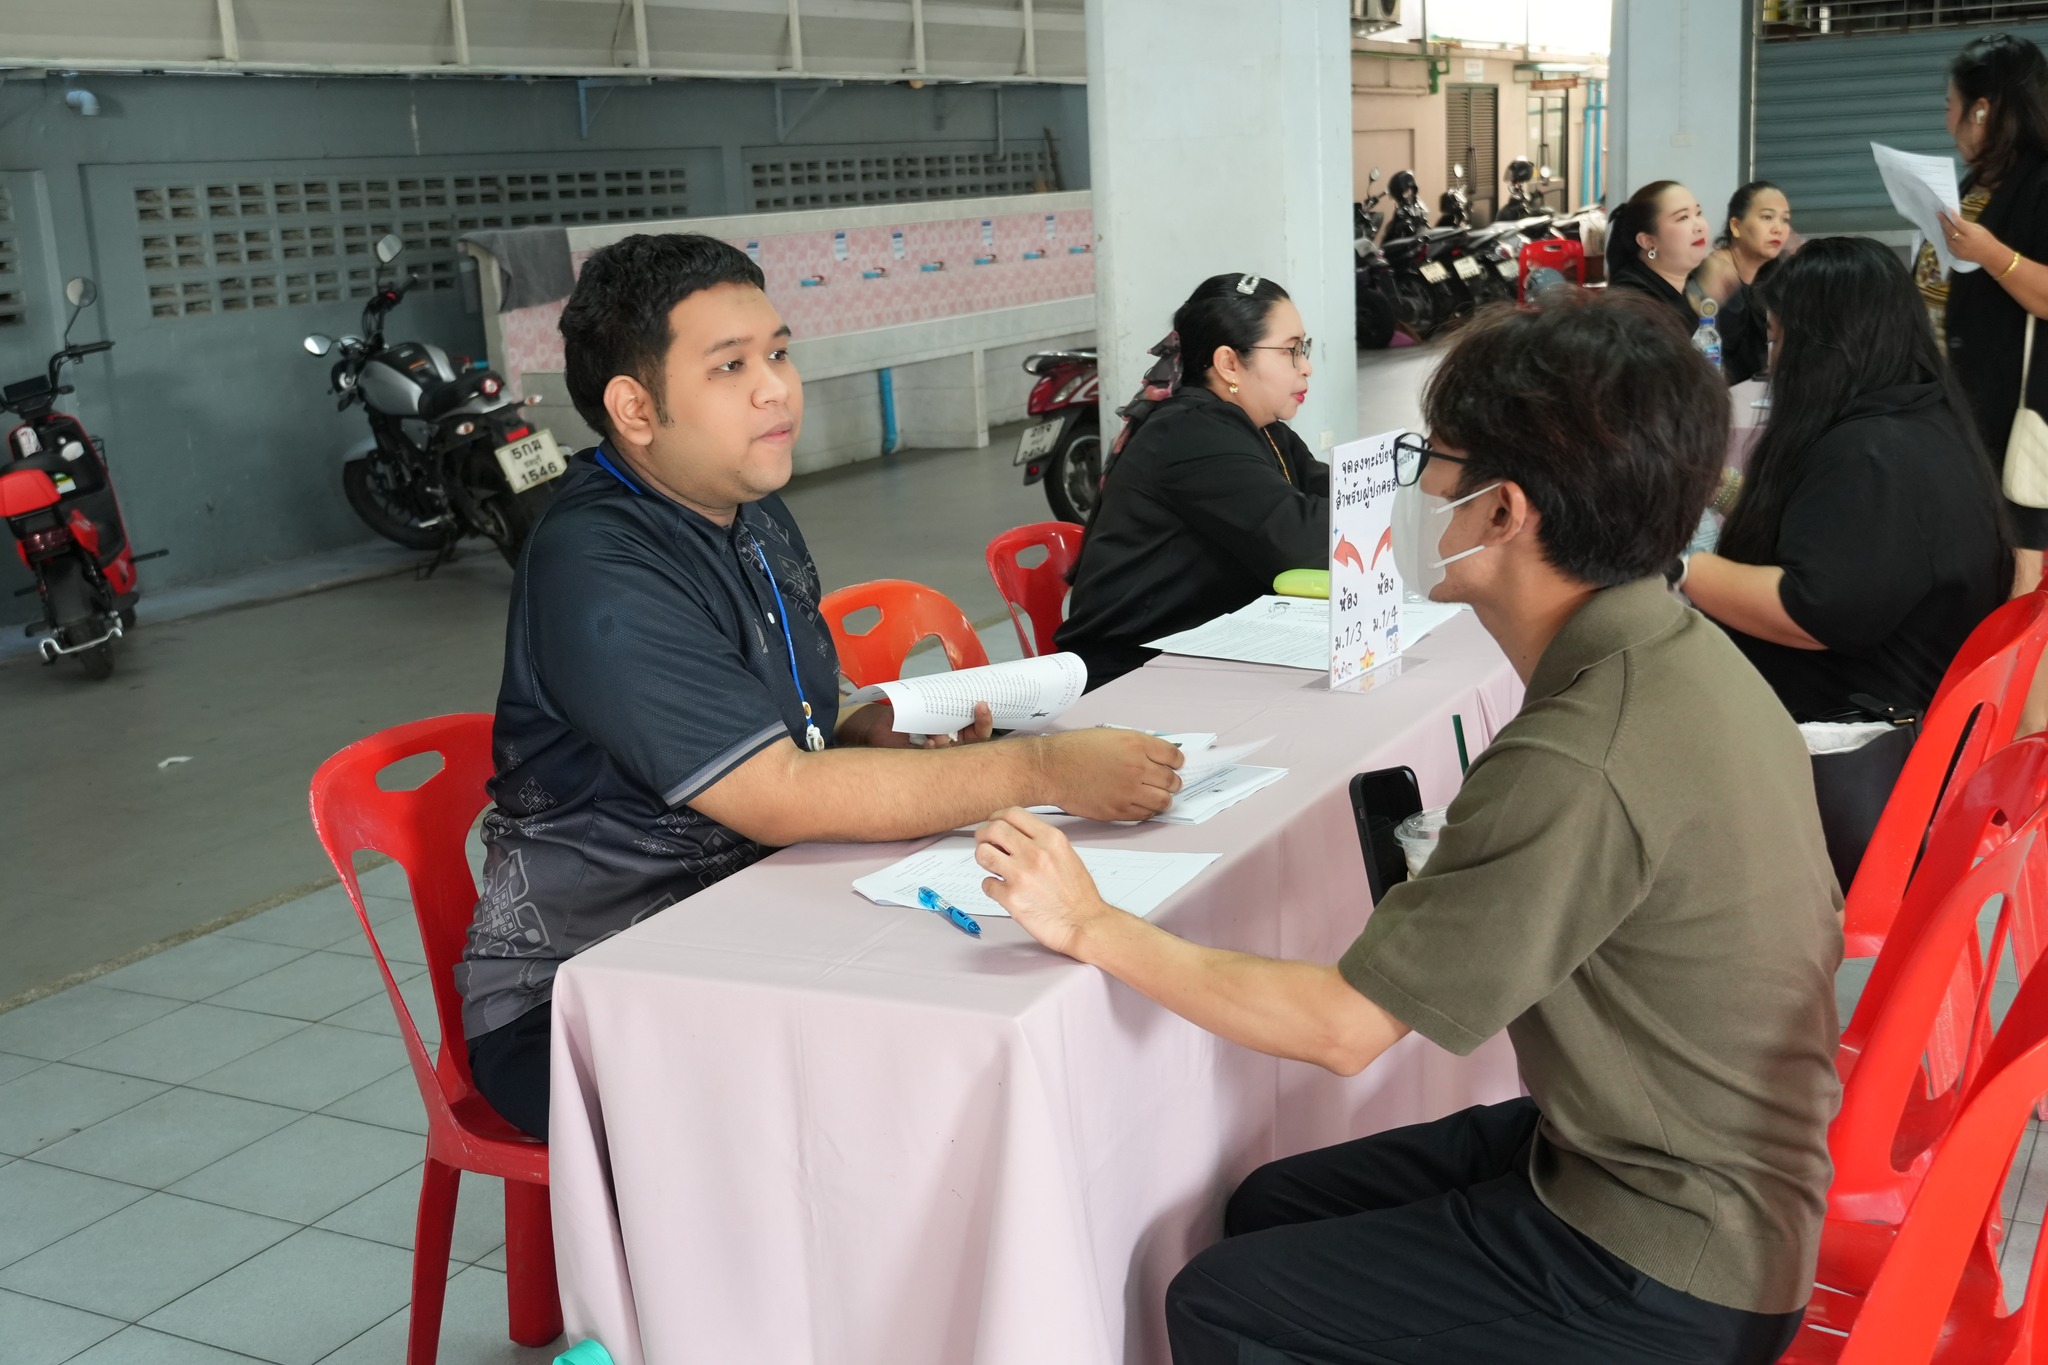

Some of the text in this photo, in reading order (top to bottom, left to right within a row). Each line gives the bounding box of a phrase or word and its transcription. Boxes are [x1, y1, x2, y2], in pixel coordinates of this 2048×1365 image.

[521, 462, 557, 485] 1546
[1335, 476, 1399, 510] สำหรับผู้ปกครอ
[1376, 572, 1394, 595] ห้อง
[1340, 587, 1358, 612] ห้อง
[1373, 605, 1398, 631] ม.1/4
[1335, 621, 1362, 651] ม.1/3
